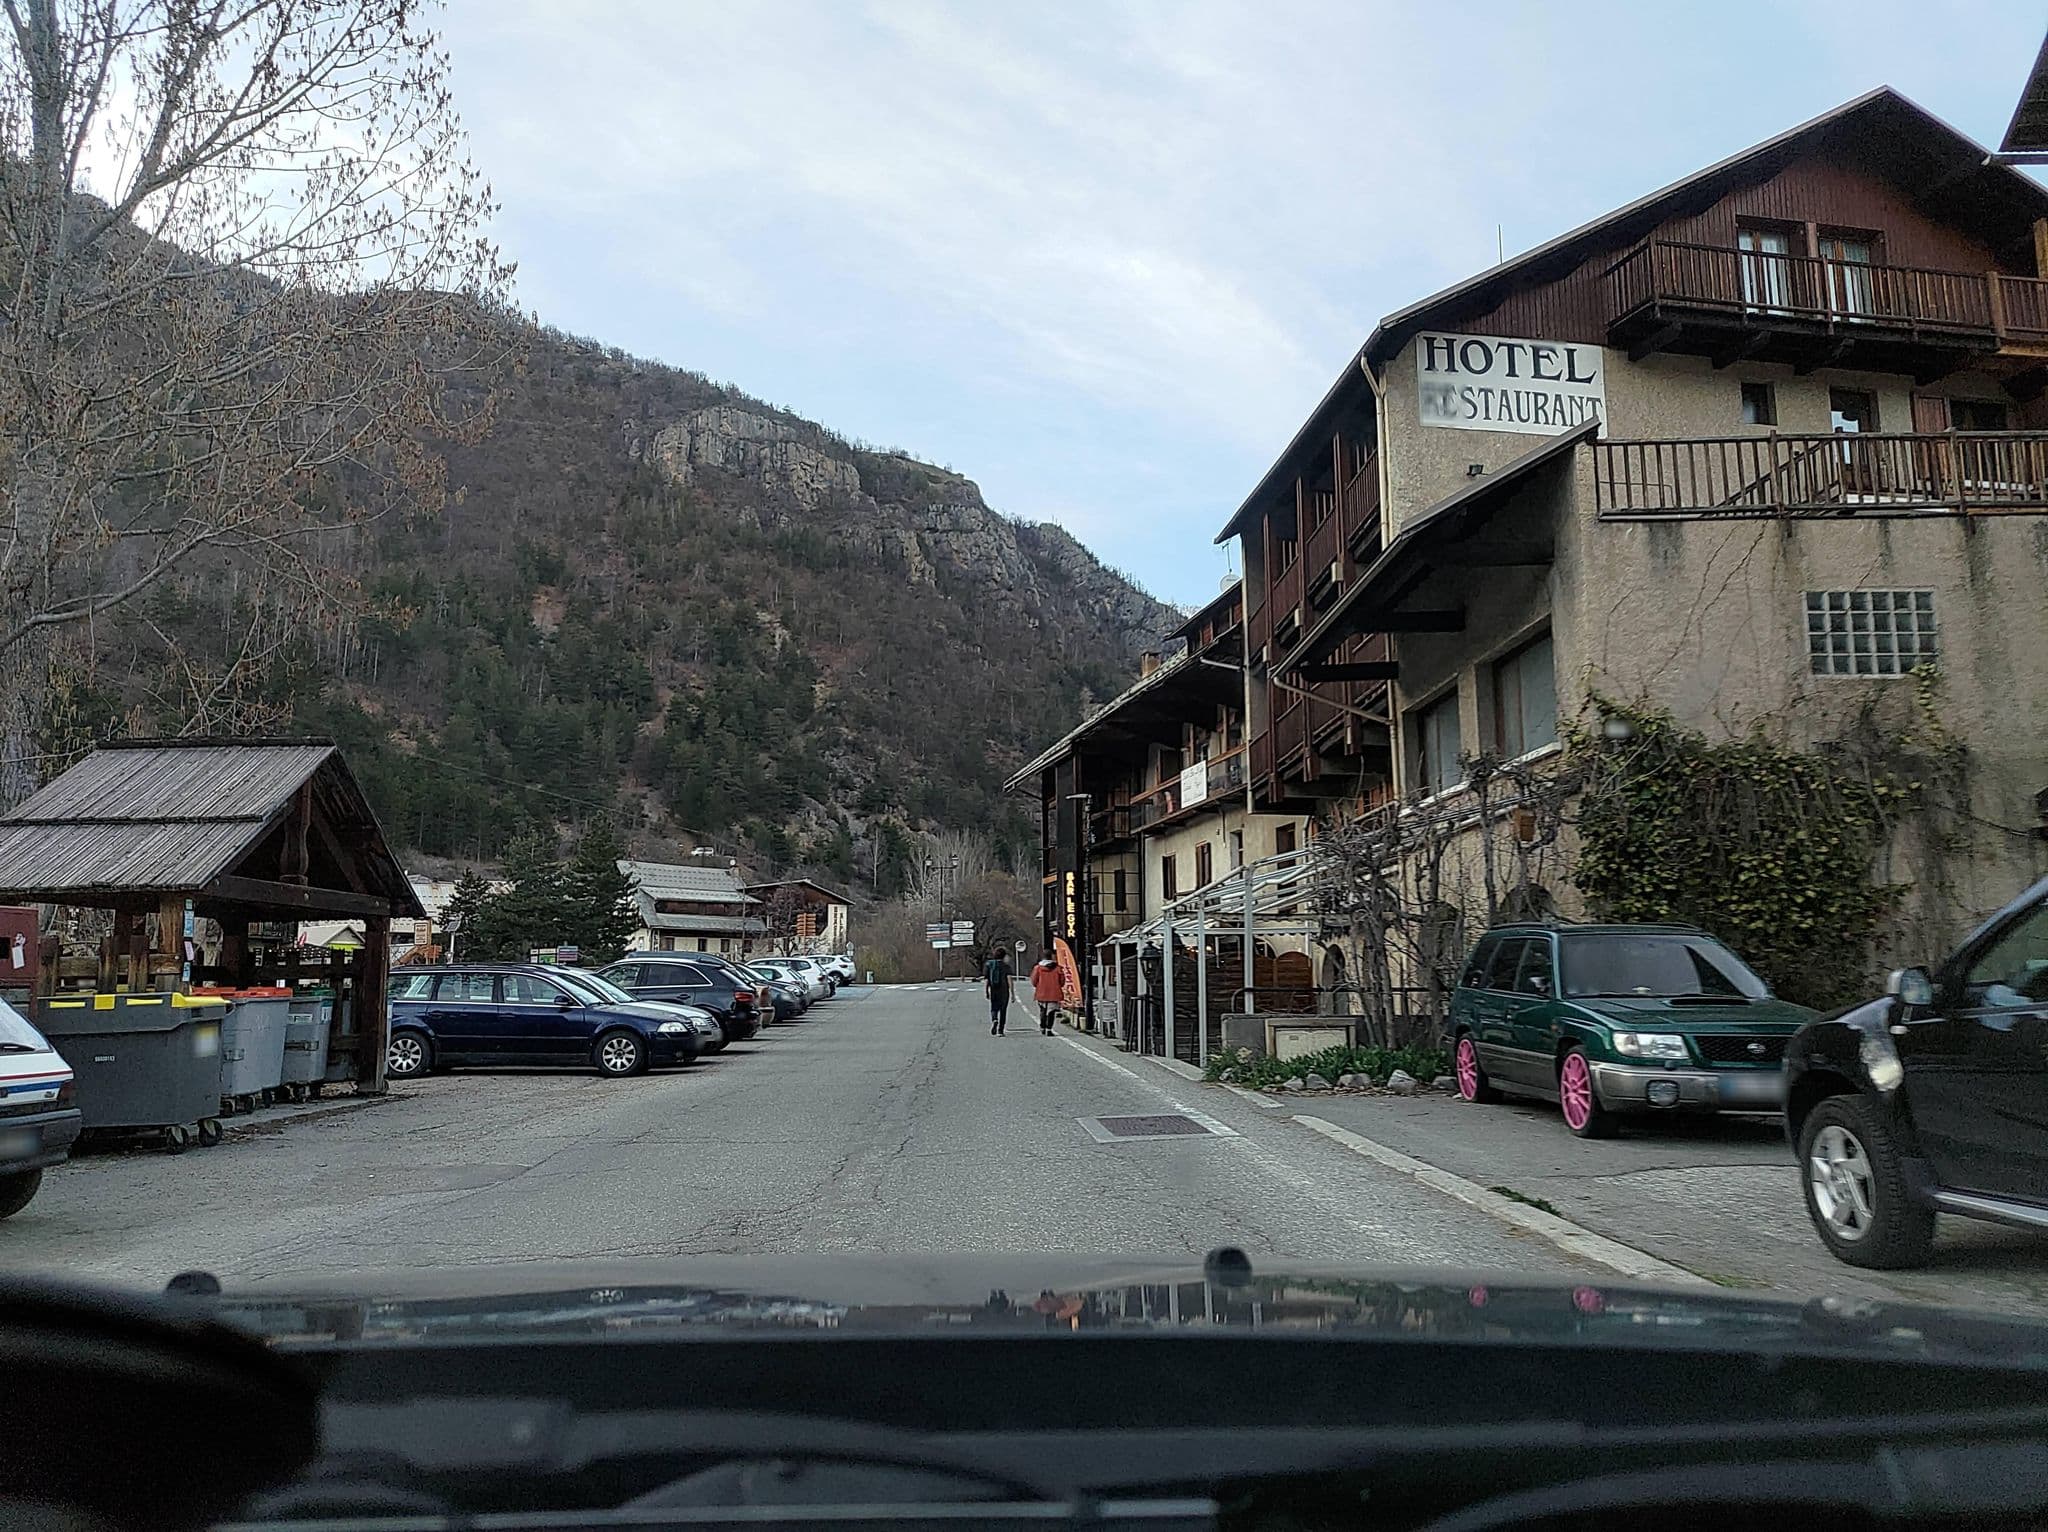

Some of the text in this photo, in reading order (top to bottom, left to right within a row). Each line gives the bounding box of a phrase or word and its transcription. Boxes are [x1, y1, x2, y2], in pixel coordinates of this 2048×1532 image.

[1423, 336, 1597, 384] HOTEL
[1422, 382, 1602, 427] STAURANT
[1066, 871, 1076, 938] BAR LE GYR
